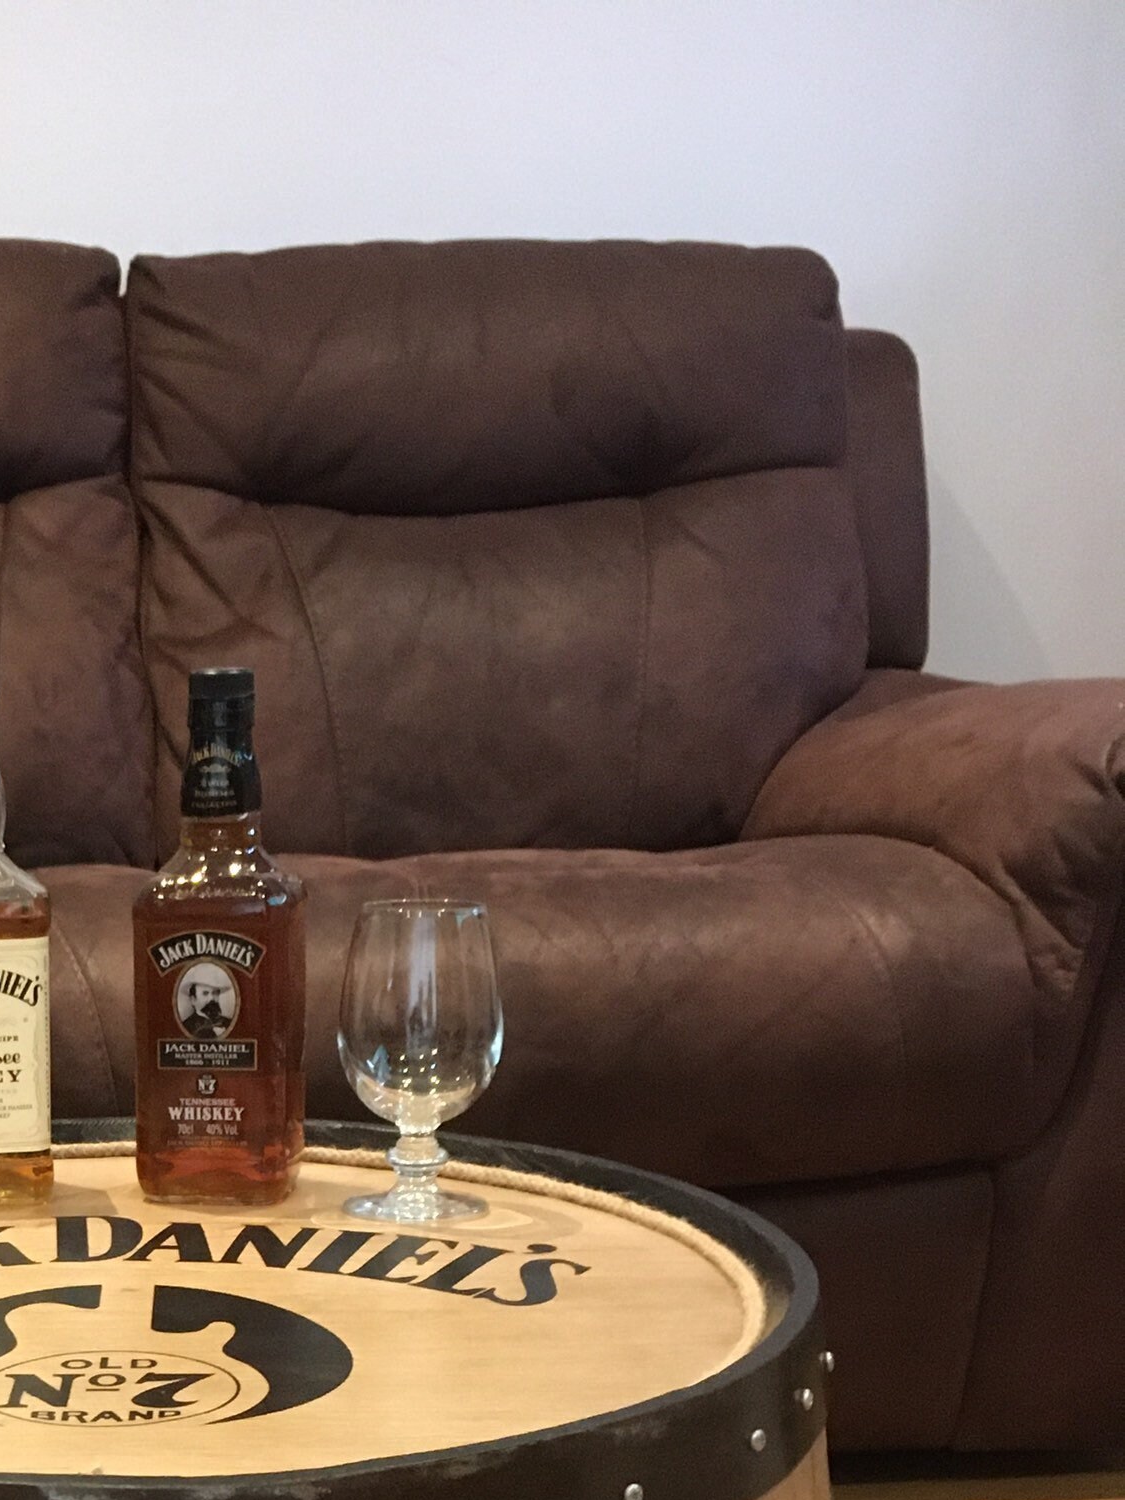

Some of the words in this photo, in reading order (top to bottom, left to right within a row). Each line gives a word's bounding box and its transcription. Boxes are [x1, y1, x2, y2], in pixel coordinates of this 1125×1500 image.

[158, 939, 195, 968] JACK
[195, 933, 255, 967] DANIEL'S
[165, 1043, 196, 1054] JACK
[199, 1043, 250, 1053] DANIEL
[179, 1098, 236, 1106] TENNESSEE
[168, 1107, 245, 1122] WHISKEY
[49, 1215, 592, 1306] DANIEL'S
[60, 1356, 158, 1369] OLD
[30, 1410, 181, 1424] BRAND
